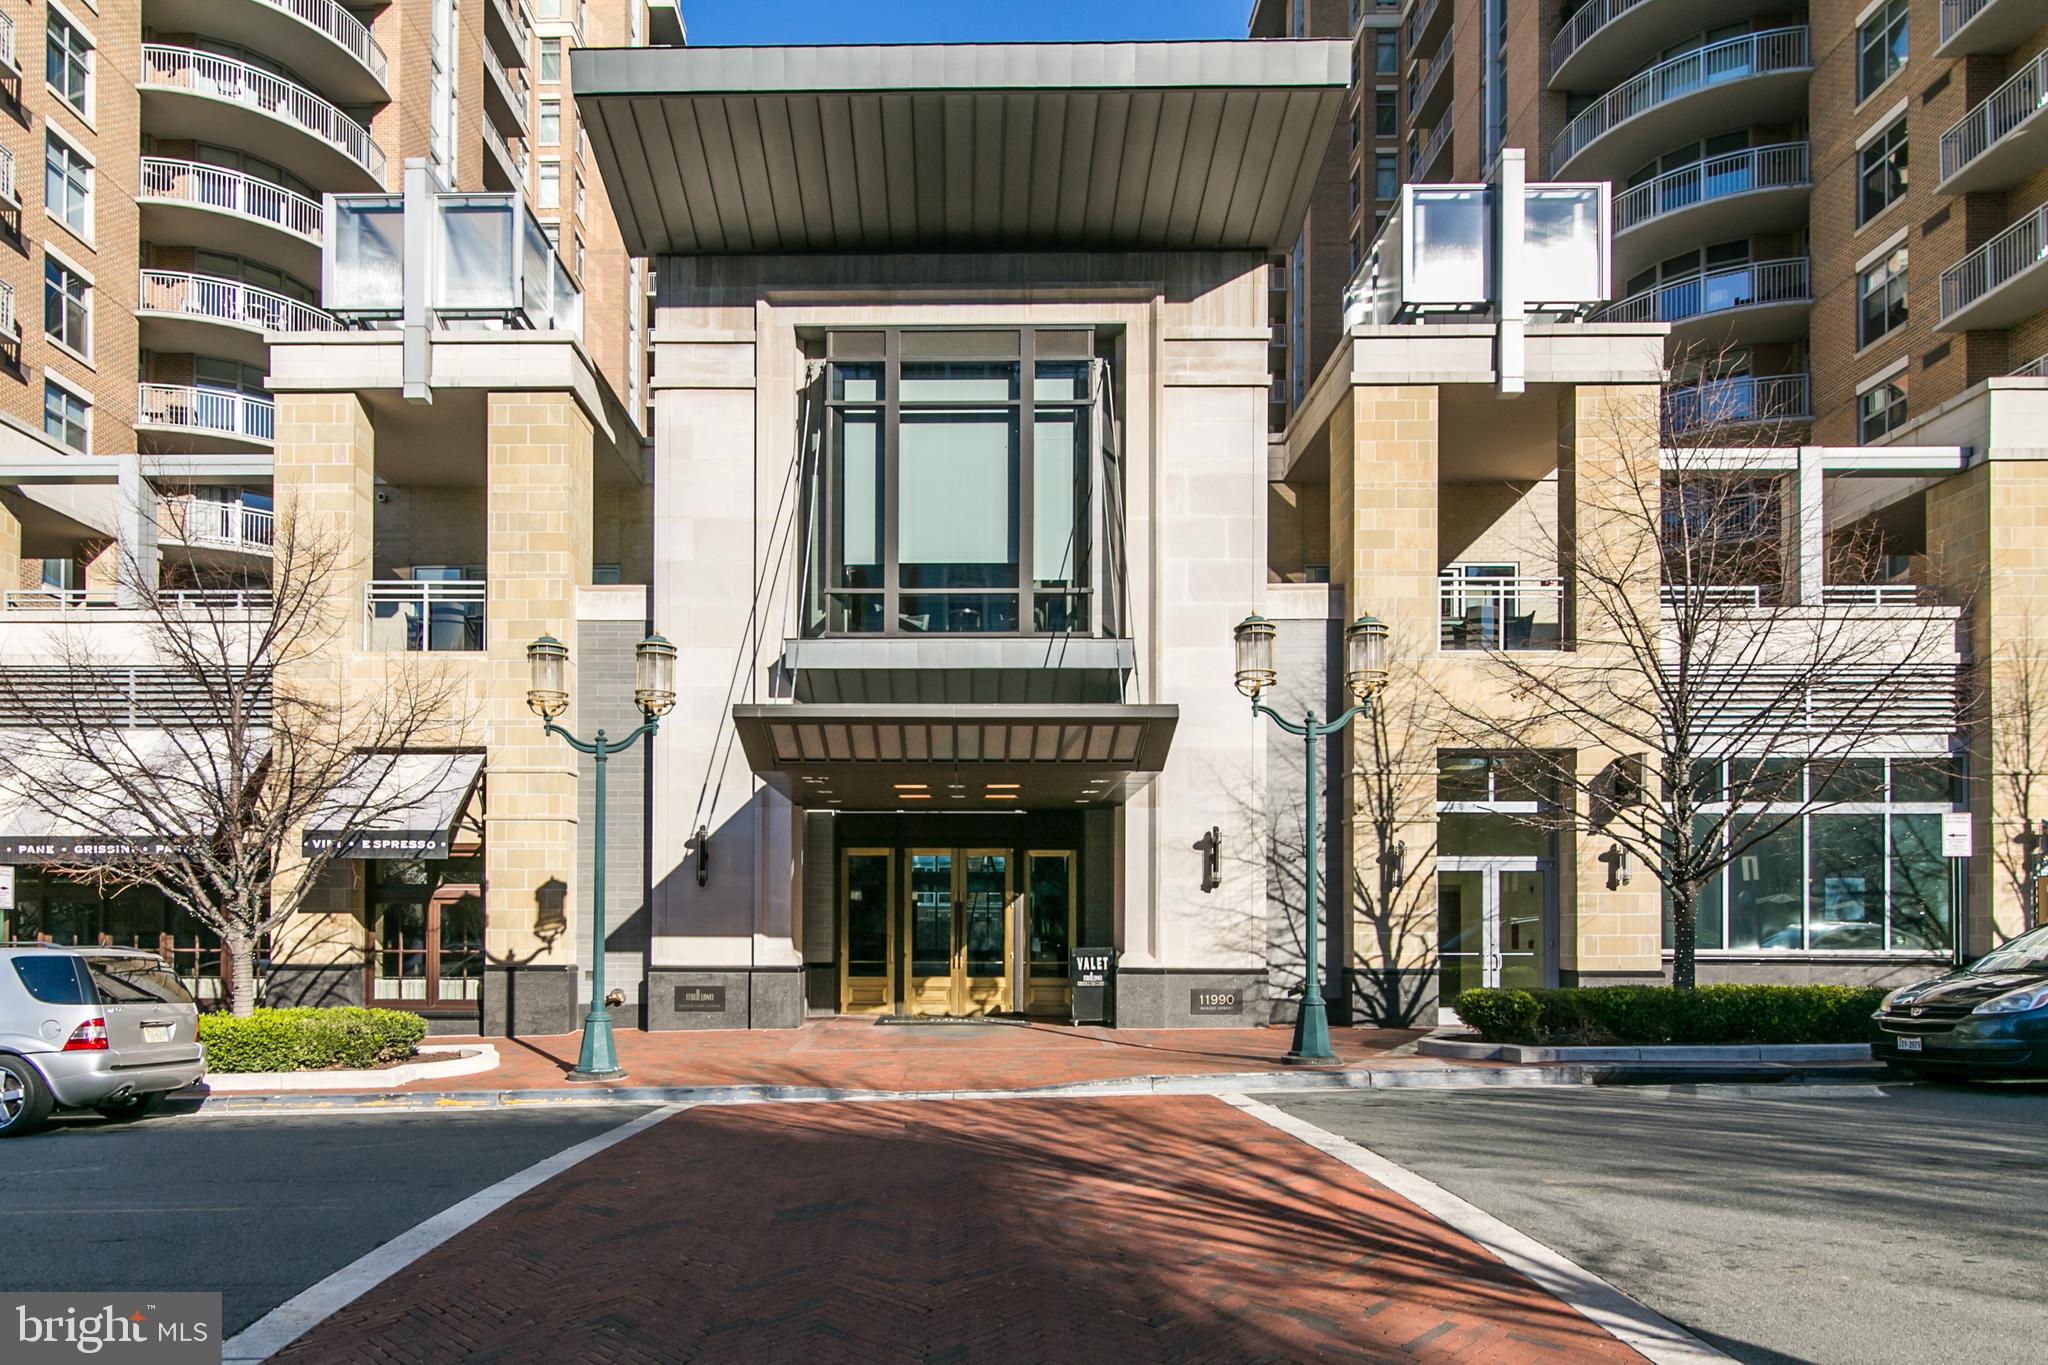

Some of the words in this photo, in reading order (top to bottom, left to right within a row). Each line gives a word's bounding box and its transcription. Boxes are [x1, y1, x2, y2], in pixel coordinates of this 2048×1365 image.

[18, 844, 55, 854] PANE
[361, 839, 437, 850] ESPRESSO
[1076, 956, 1109, 971] VALET
[1199, 993, 1235, 1006] 11990
